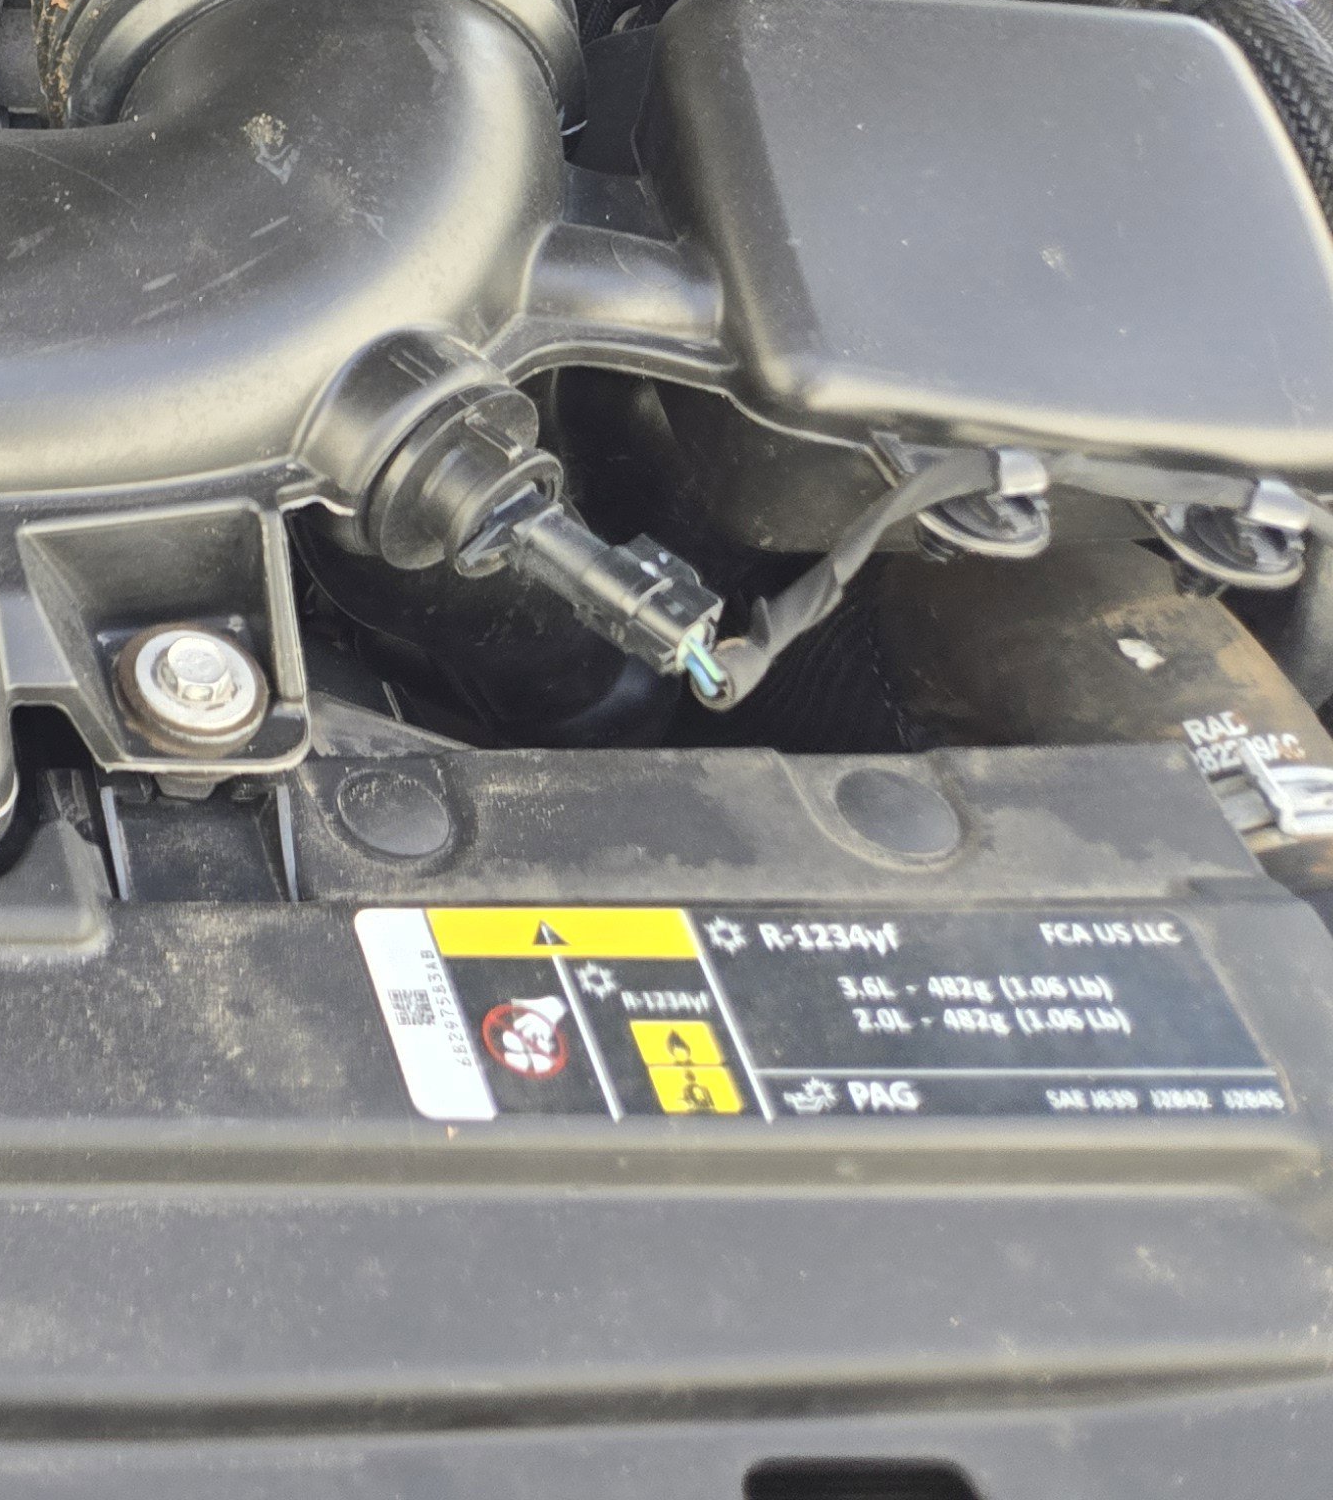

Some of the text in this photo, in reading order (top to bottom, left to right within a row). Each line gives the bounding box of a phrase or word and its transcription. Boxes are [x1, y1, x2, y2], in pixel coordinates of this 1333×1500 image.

[758, 921, 901, 957] R-1234yf
[1039, 921, 1183, 947] FCA US LLC
[837, 976, 900, 1000] 3.6L
[927, 976, 994, 1003] 482g
[999, 975, 1069, 1005] (1.06
[1068, 975, 1114, 1004] Lb)
[852, 1008, 914, 1033] 2.0L
[943, 1008, 1012, 1036] 482g
[1015, 1007, 1085, 1036] (1.06
[1084, 1006, 1132, 1037] Lb)
[847, 1080, 921, 1111] PAG
[1045, 1088, 1088, 1110] SAE
